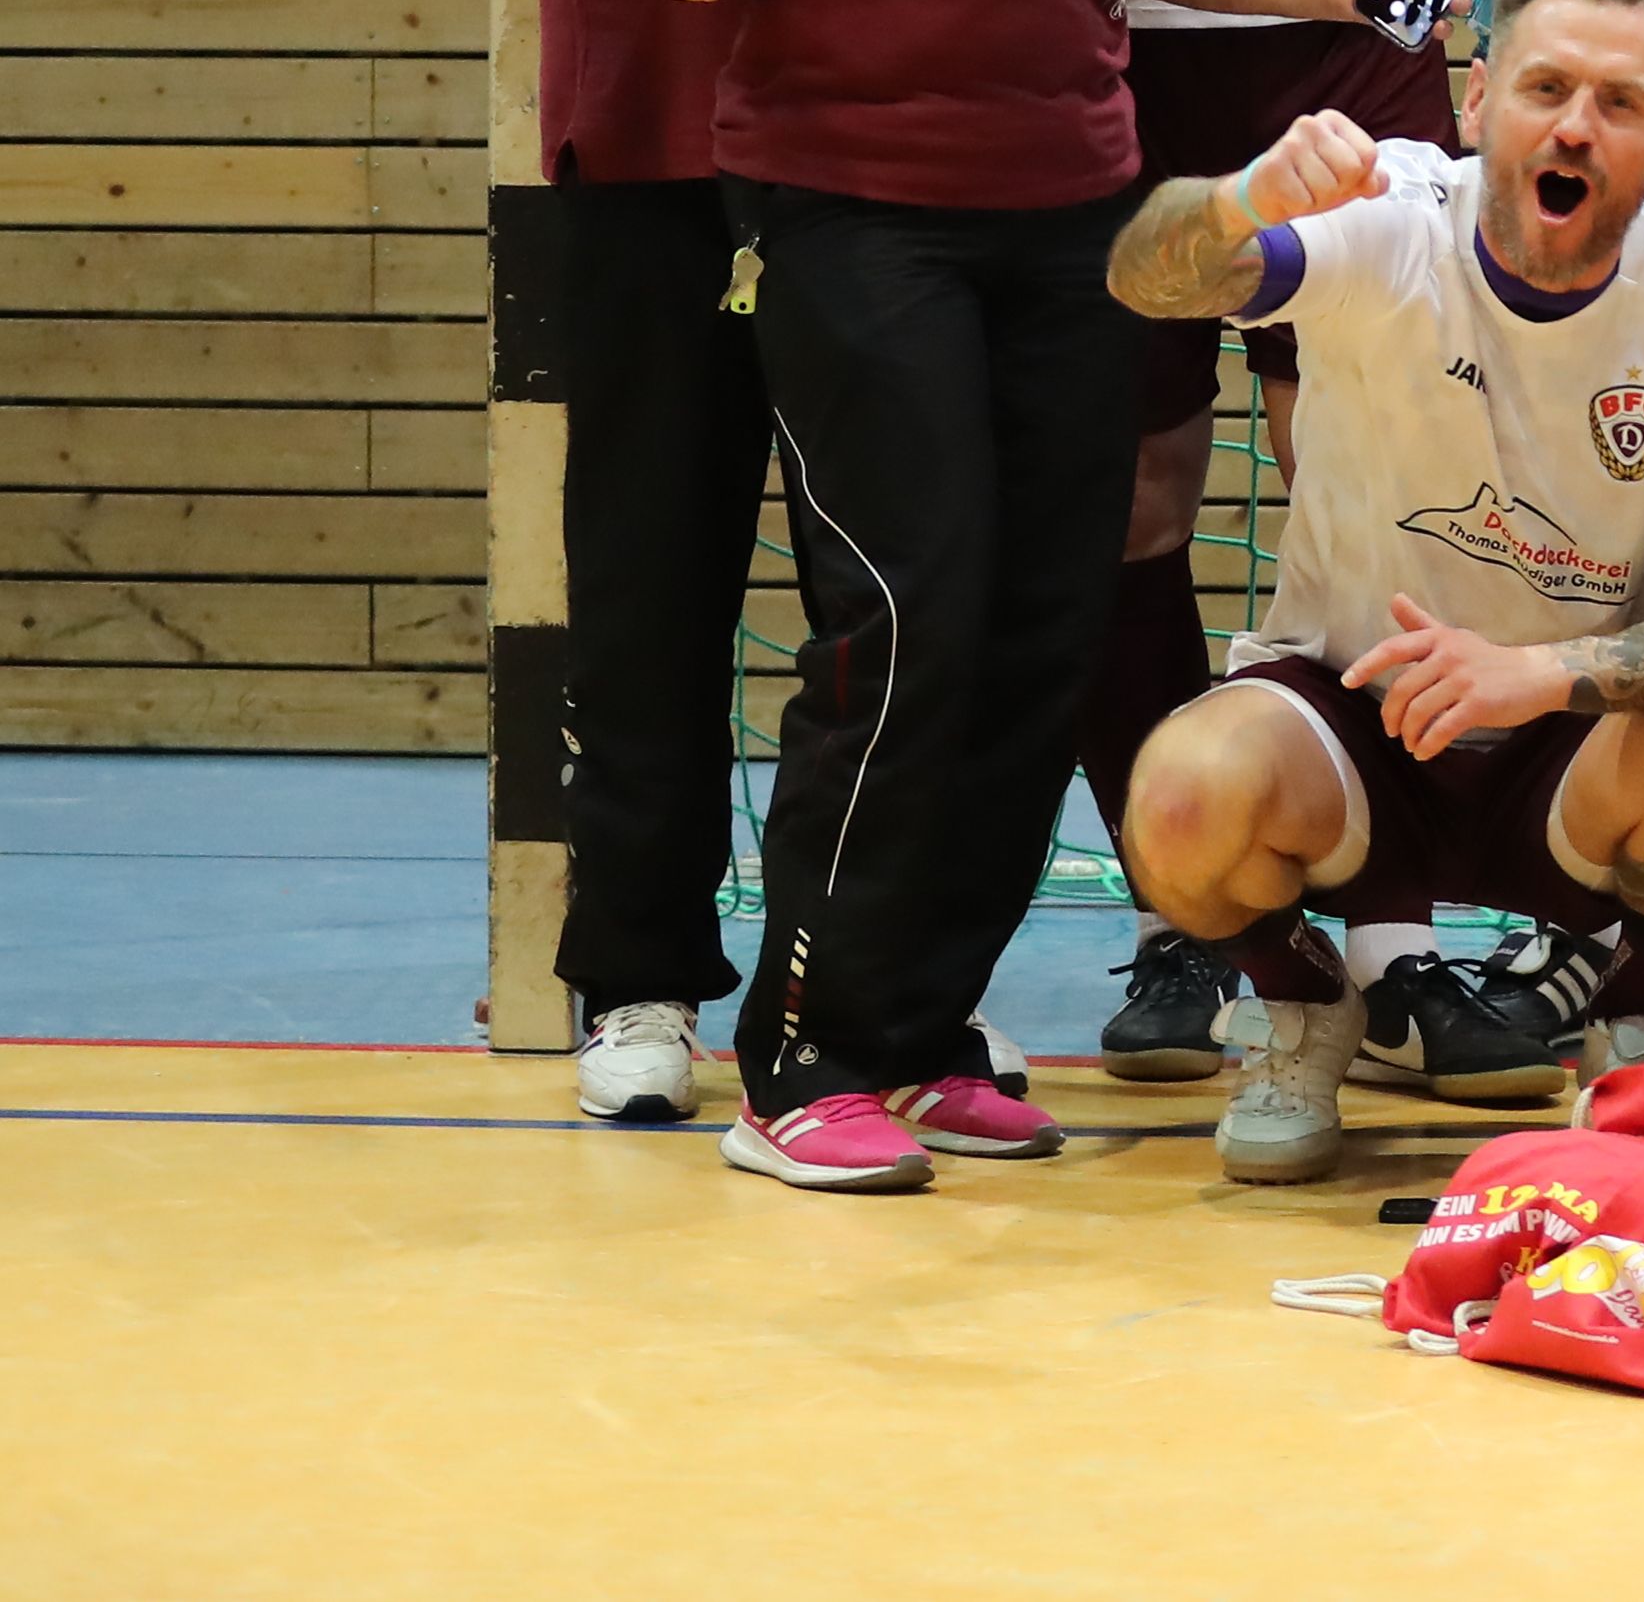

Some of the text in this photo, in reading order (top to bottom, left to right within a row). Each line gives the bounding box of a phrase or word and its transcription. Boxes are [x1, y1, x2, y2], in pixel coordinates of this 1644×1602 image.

[1448, 520, 1509, 555] Thomas
[1571, 572, 1627, 596] GmbH
[1483, 510, 1631, 579] Dachdeckerei
[1452, 1223, 1485, 1243] ES
